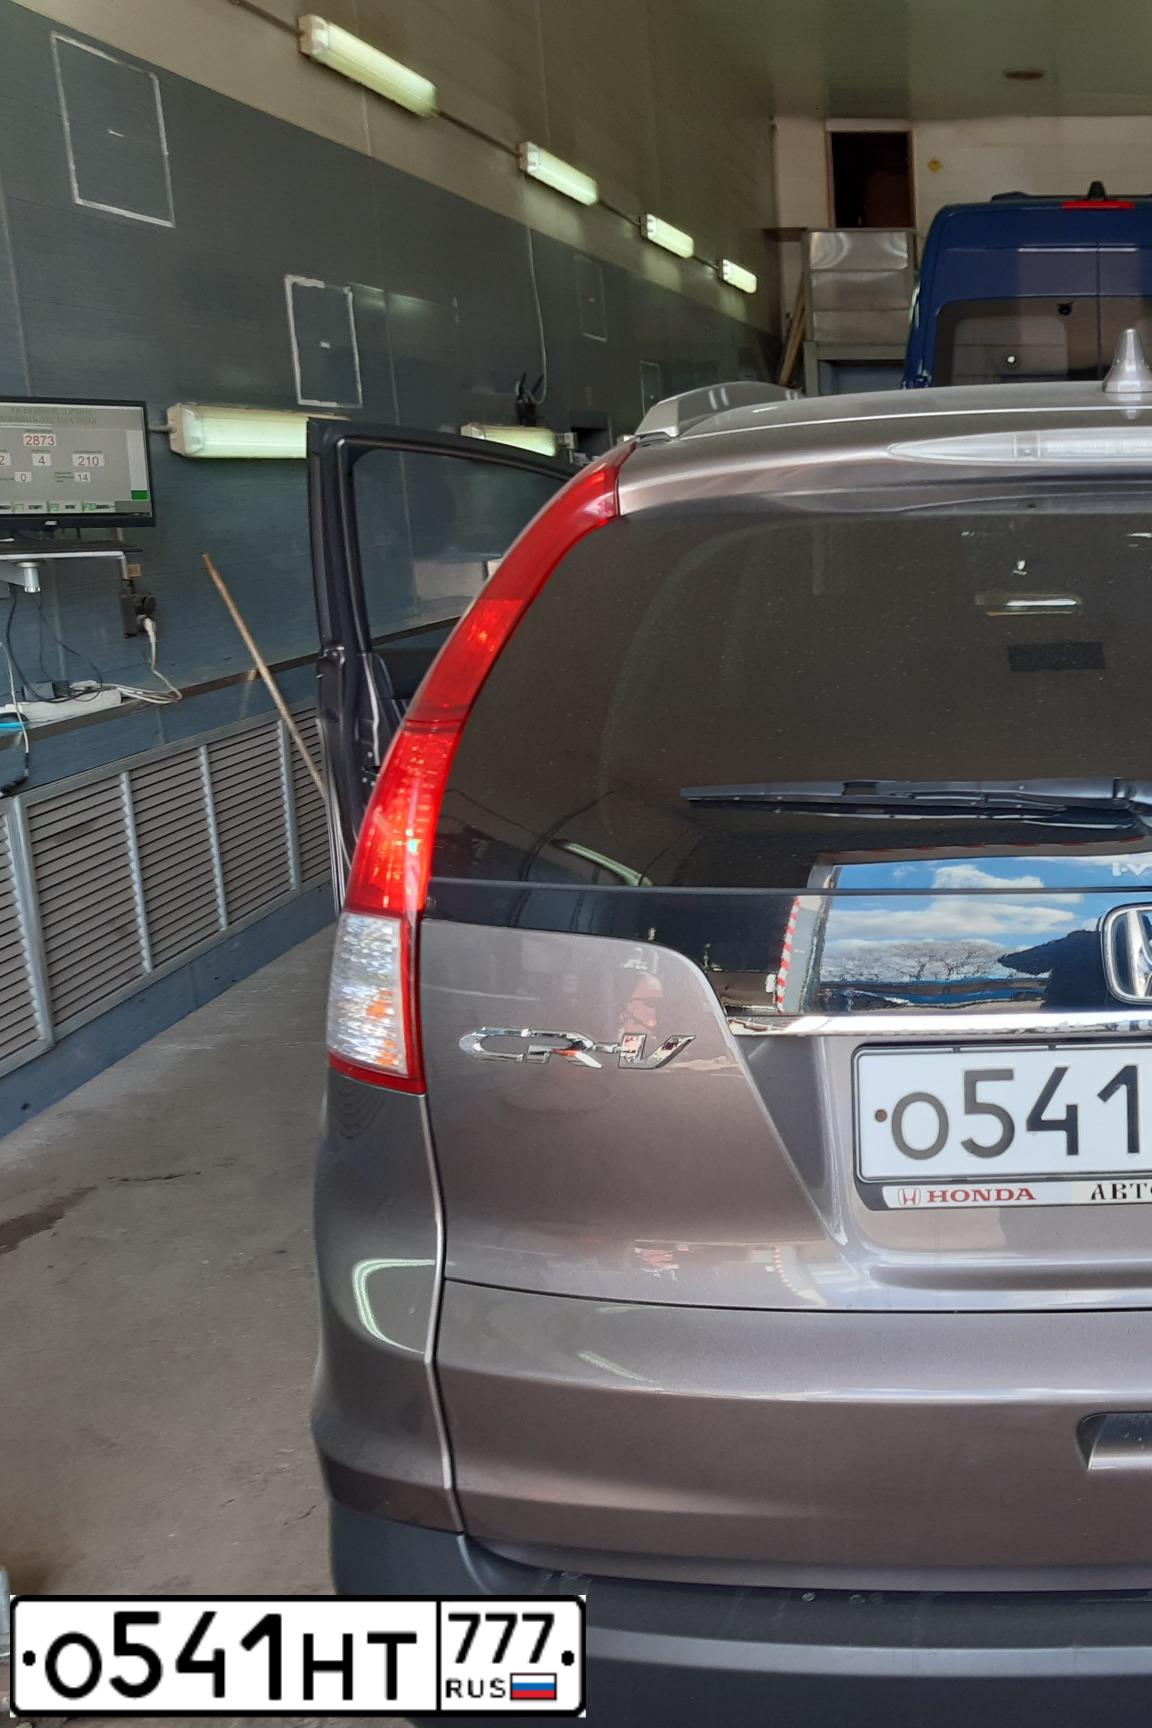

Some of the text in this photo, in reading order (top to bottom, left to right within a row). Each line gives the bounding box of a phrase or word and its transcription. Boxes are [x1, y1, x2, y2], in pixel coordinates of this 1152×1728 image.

[25, 435, 55, 446] 2873
[38, 456, 46, 466] 4
[77, 456, 100, 466] 210
[20, 474, 27, 482] 0
[78, 474, 88, 482] 14
[458, 1027, 696, 1070] CR-V
[927, 1187, 1036, 1203] HONDA
